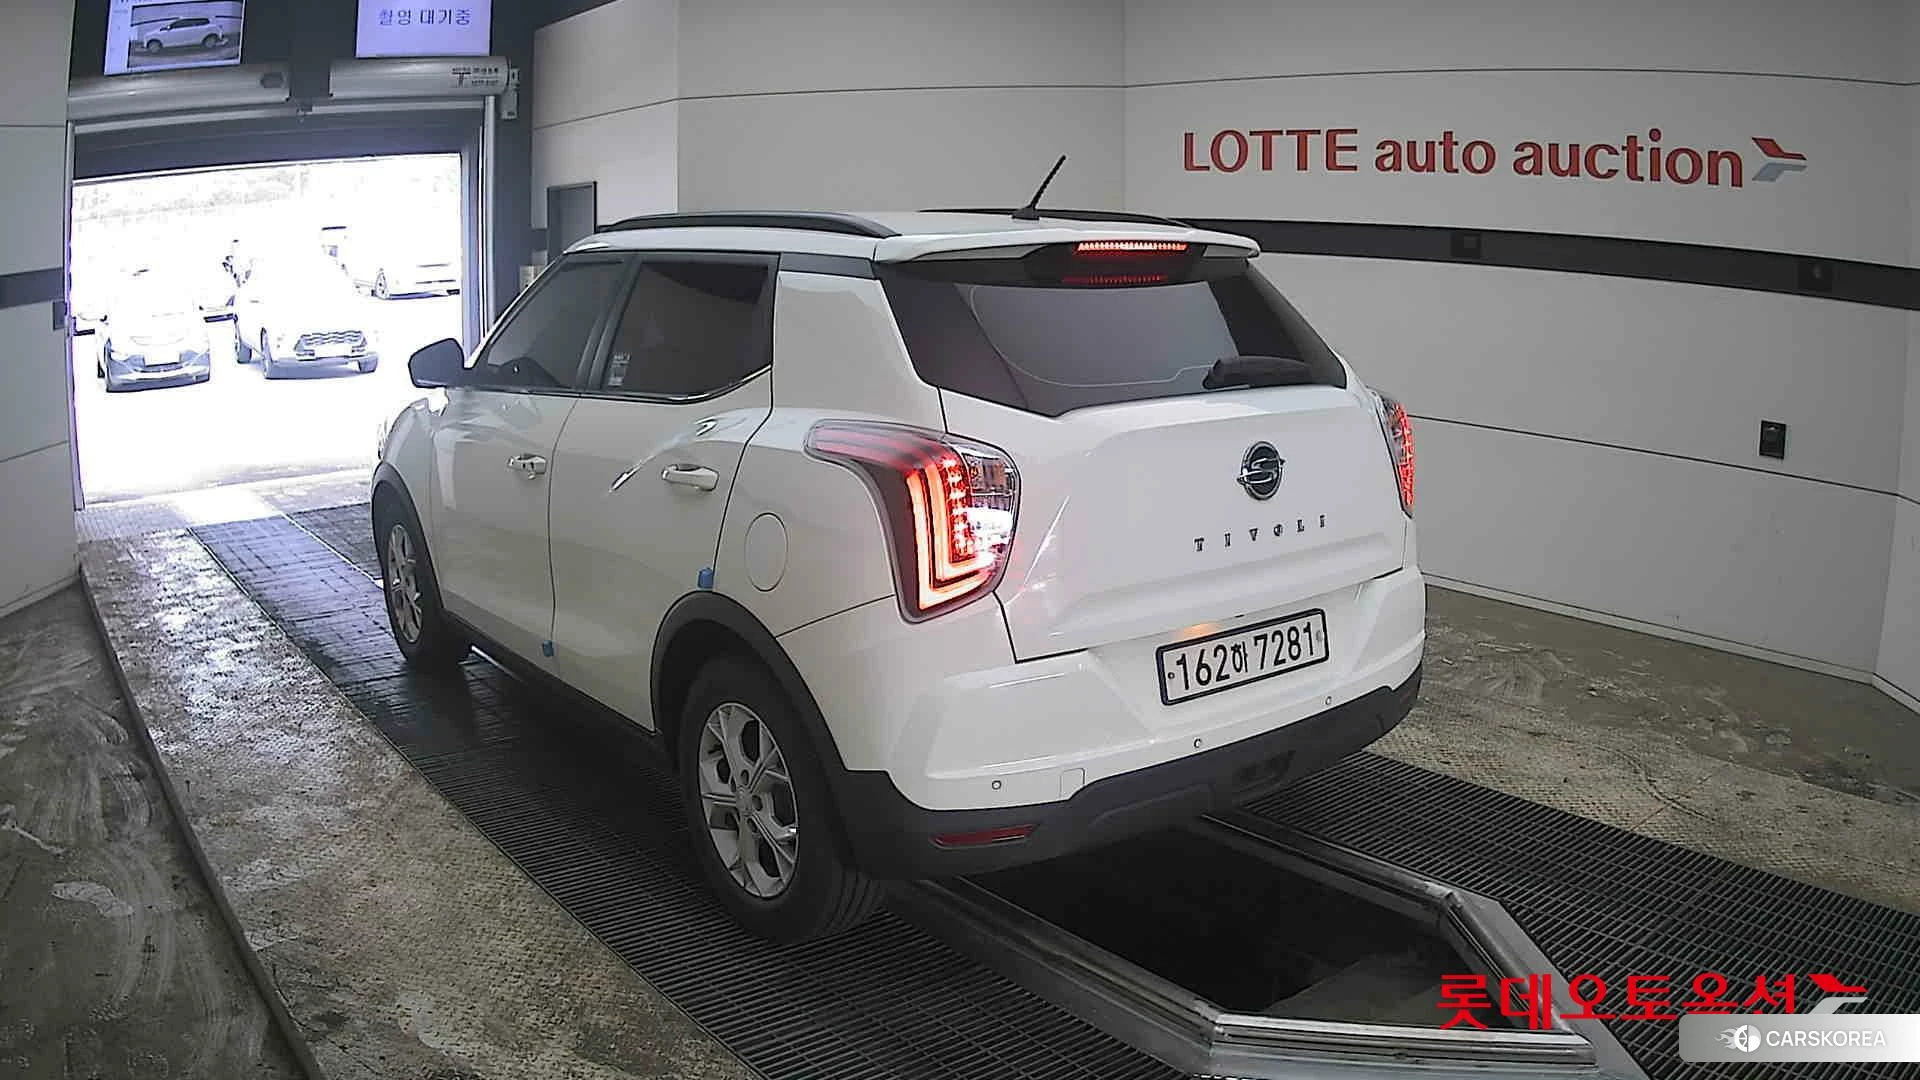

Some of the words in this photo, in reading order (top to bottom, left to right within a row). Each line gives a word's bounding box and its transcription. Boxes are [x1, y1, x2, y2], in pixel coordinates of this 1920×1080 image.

[1184, 129, 1357, 172] LOTTE
[1375, 131, 1497, 175] auto
[1513, 128, 1743, 188] auction
[1194, 514, 1326, 552] TIVOLI
